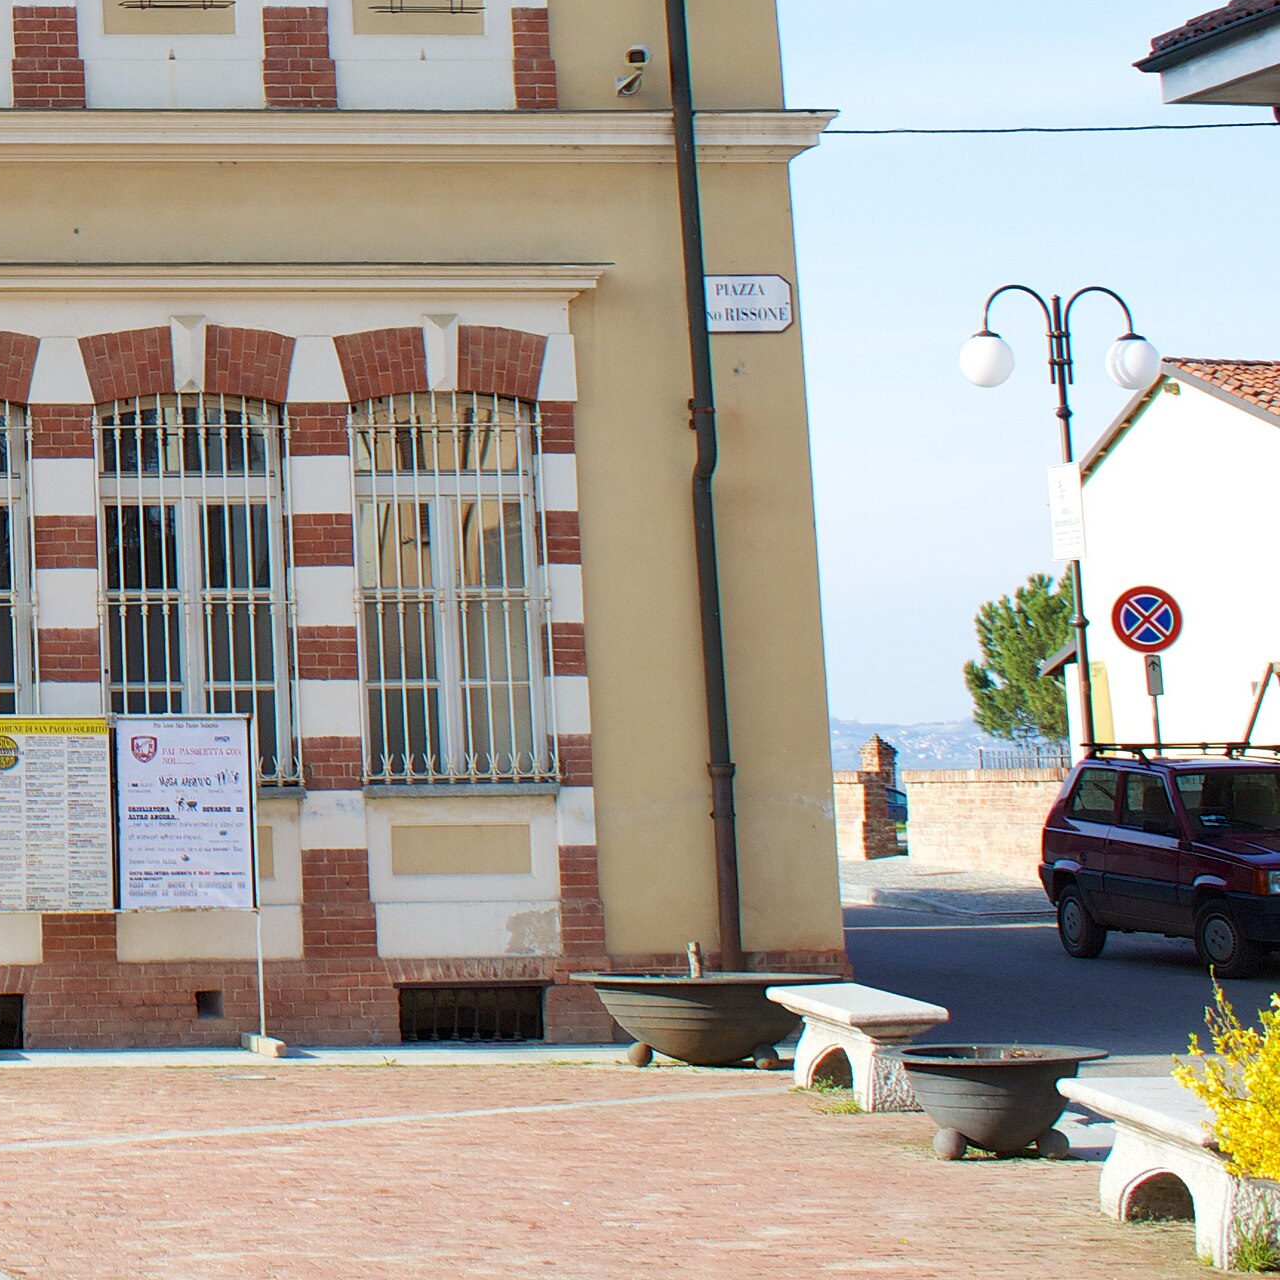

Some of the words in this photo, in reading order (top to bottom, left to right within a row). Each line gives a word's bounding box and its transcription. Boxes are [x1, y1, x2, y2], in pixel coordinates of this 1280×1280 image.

[715, 283, 765, 296] PIAZZA
[724, 307, 788, 322] RISSONE
[34, 725, 47, 734] SAN
[49, 725, 72, 734] PAOLO
[74, 725, 108, 734] SOLBRITO
[162, 747, 175, 756] FAI
[179, 747, 224, 756] PASQUETTA
[225, 747, 242, 756] CON
[158, 775, 178, 788] MEGA
